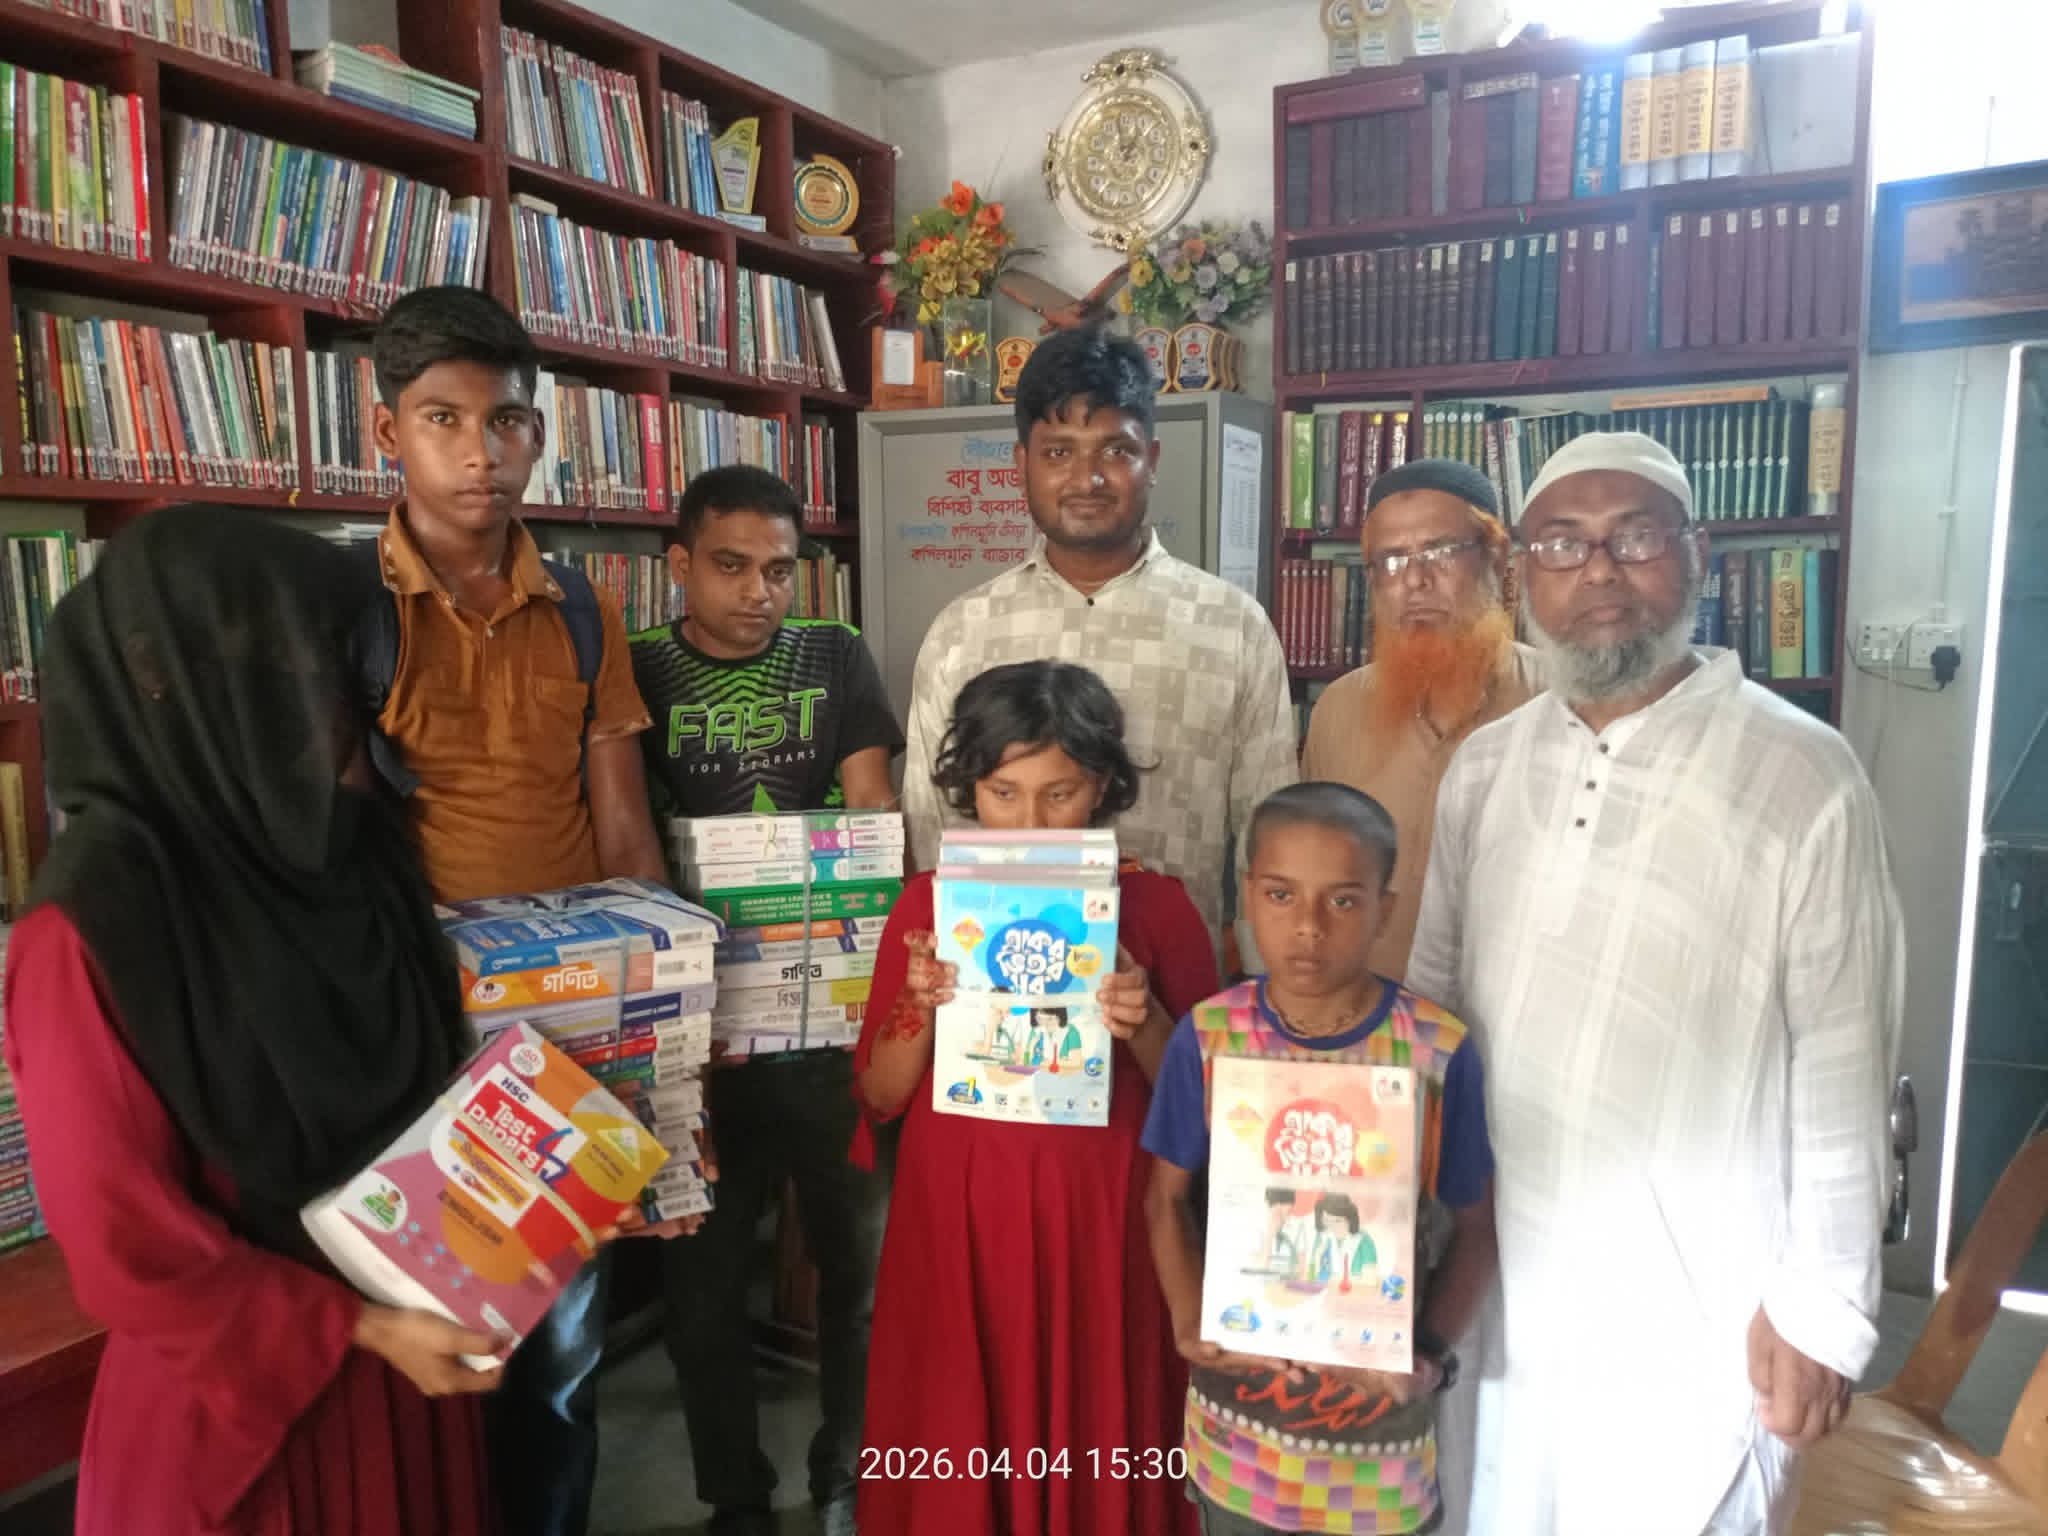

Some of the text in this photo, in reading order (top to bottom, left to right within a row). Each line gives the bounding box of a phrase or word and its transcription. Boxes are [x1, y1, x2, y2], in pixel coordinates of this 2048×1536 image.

[946, 467, 982, 495] বাবু
[926, 496, 973, 517] বিশিষ্ট
[668, 687, 827, 757] FAST
[543, 967, 599, 993] গণিত
[500, 1076, 531, 1104] HSC
[491, 1101, 538, 1142] Test
